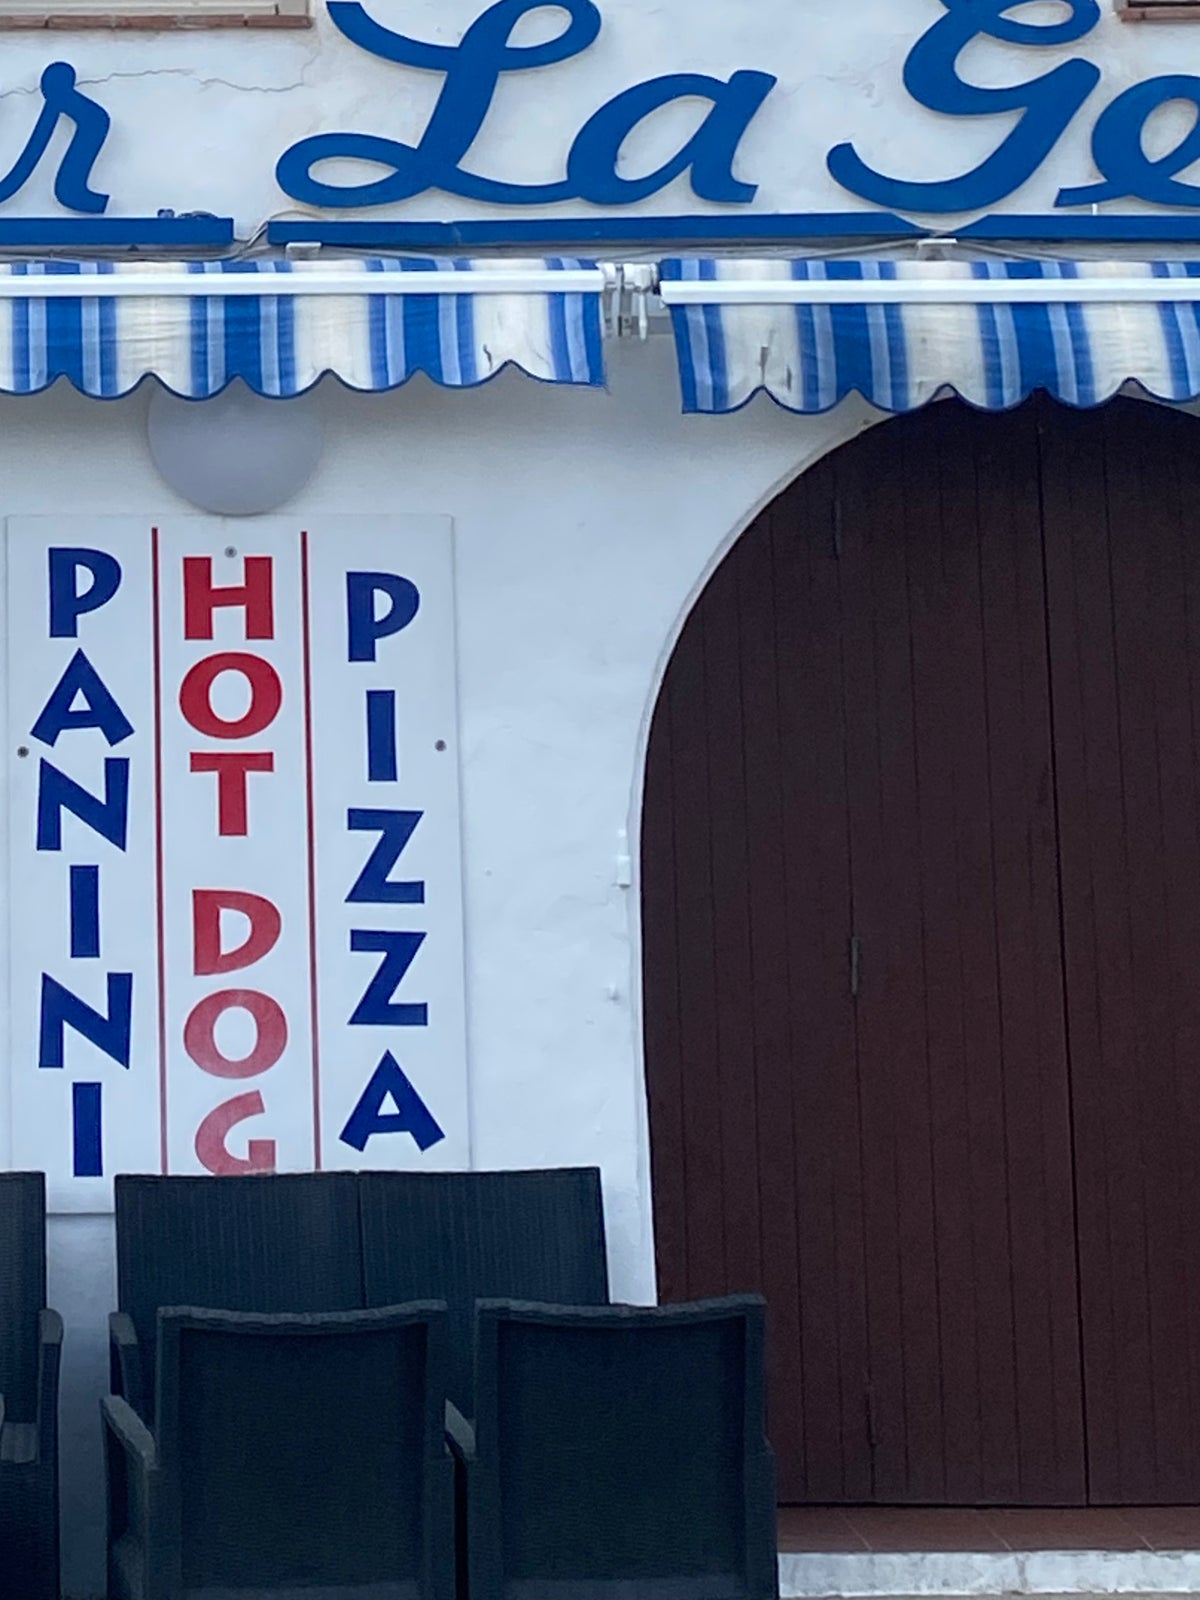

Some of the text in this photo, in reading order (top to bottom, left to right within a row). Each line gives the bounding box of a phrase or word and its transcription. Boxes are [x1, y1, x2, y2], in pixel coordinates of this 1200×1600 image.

[30, 547, 135, 1177] PANINI
[179, 556, 289, 1177] HOT DOG
[339, 571, 446, 1153] PIZZA
